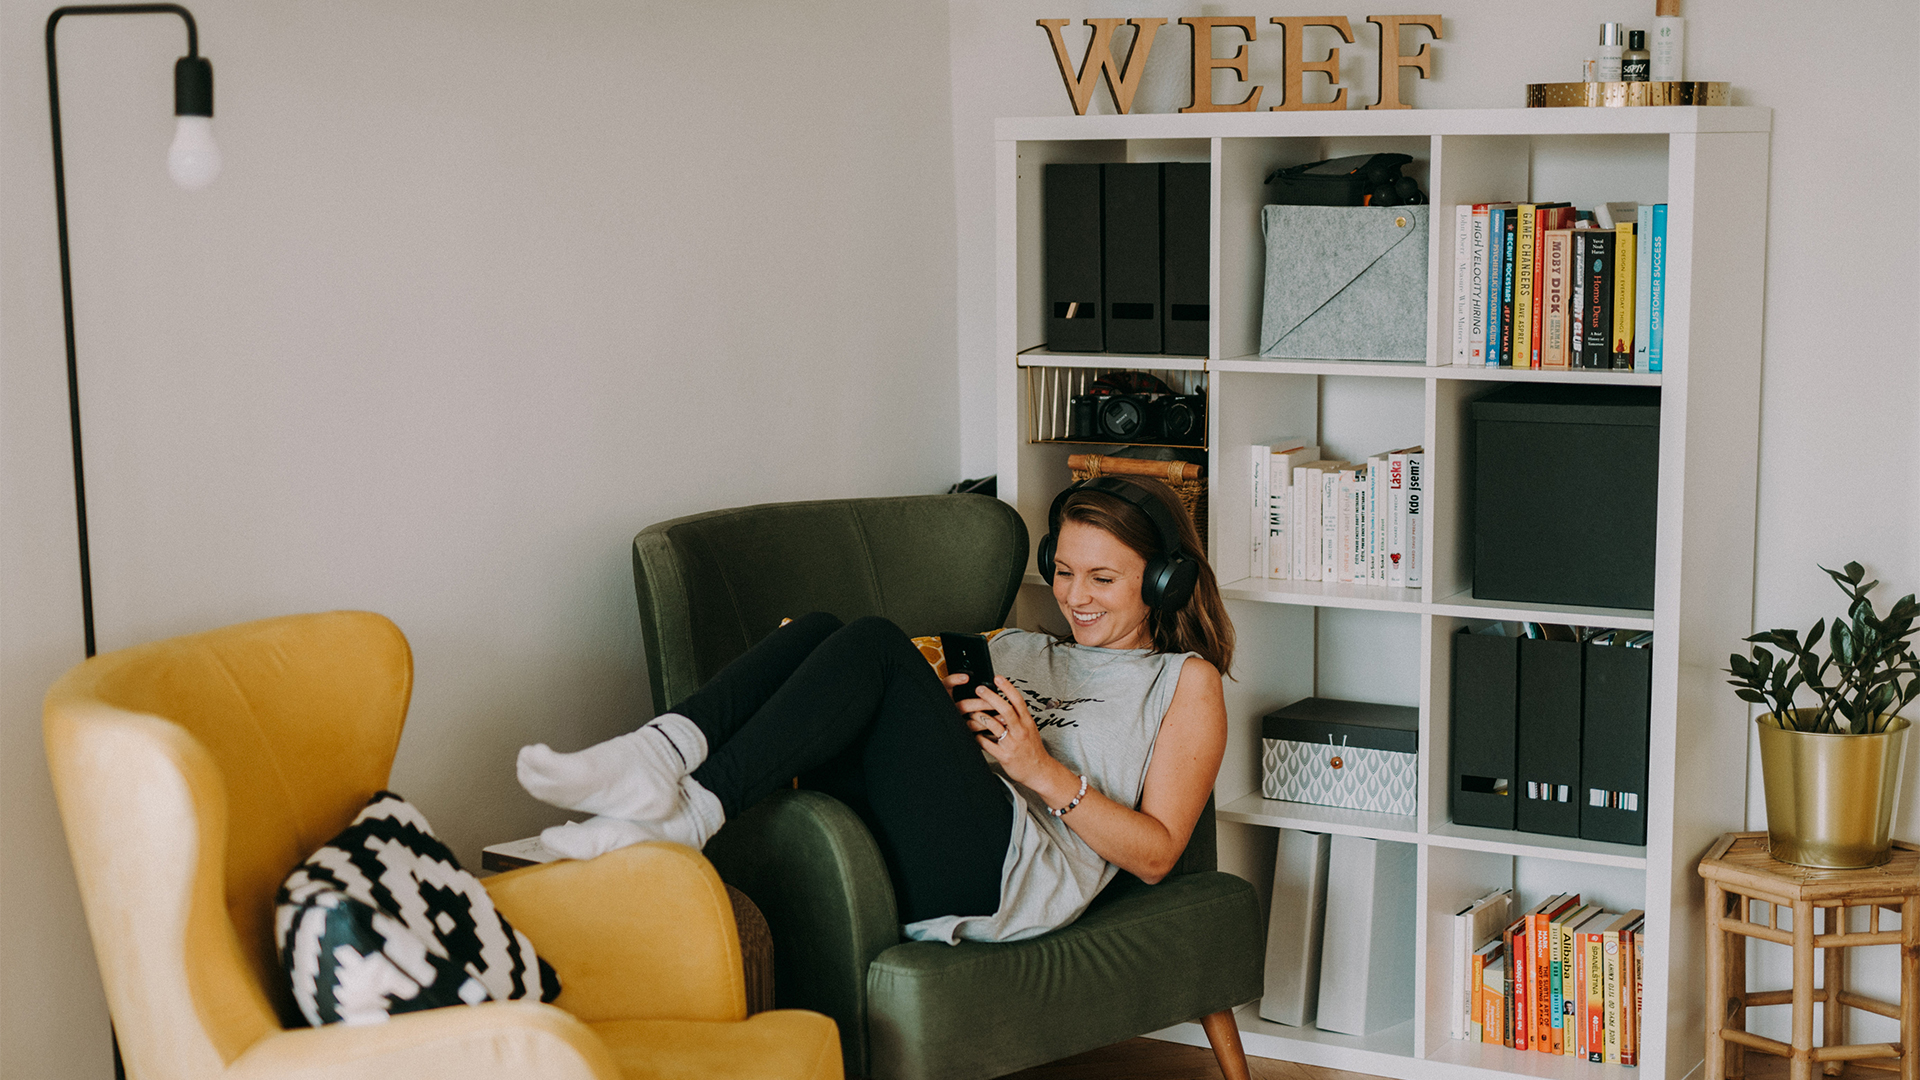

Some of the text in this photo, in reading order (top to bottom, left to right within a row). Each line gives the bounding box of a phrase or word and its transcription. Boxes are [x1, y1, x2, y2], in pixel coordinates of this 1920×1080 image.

[1036, 14, 1443, 115] WEEF
[1522, 213, 1532, 239] GAME
[1472, 221, 1484, 334] HIGH VELOCITY HIRING
[1505, 263, 1513, 302] ROCKSTARS
[1520, 244, 1532, 296] CHANGERS
[1551, 241, 1562, 313] MOBY DICK
[1592, 275, 1602, 328] Homo Deus
[1651, 279, 1660, 330] CUSTOMER
[1573, 322, 1583, 352] CLUB
[1390, 461, 1401, 489] Láska
[1409, 460, 1421, 491] jsem?
[1409, 495, 1419, 514] Kdo
[1592, 1015, 1598, 1024] 40
[1609, 1000, 1614, 1008] OD
[1544, 1018, 1549, 1026] OF
